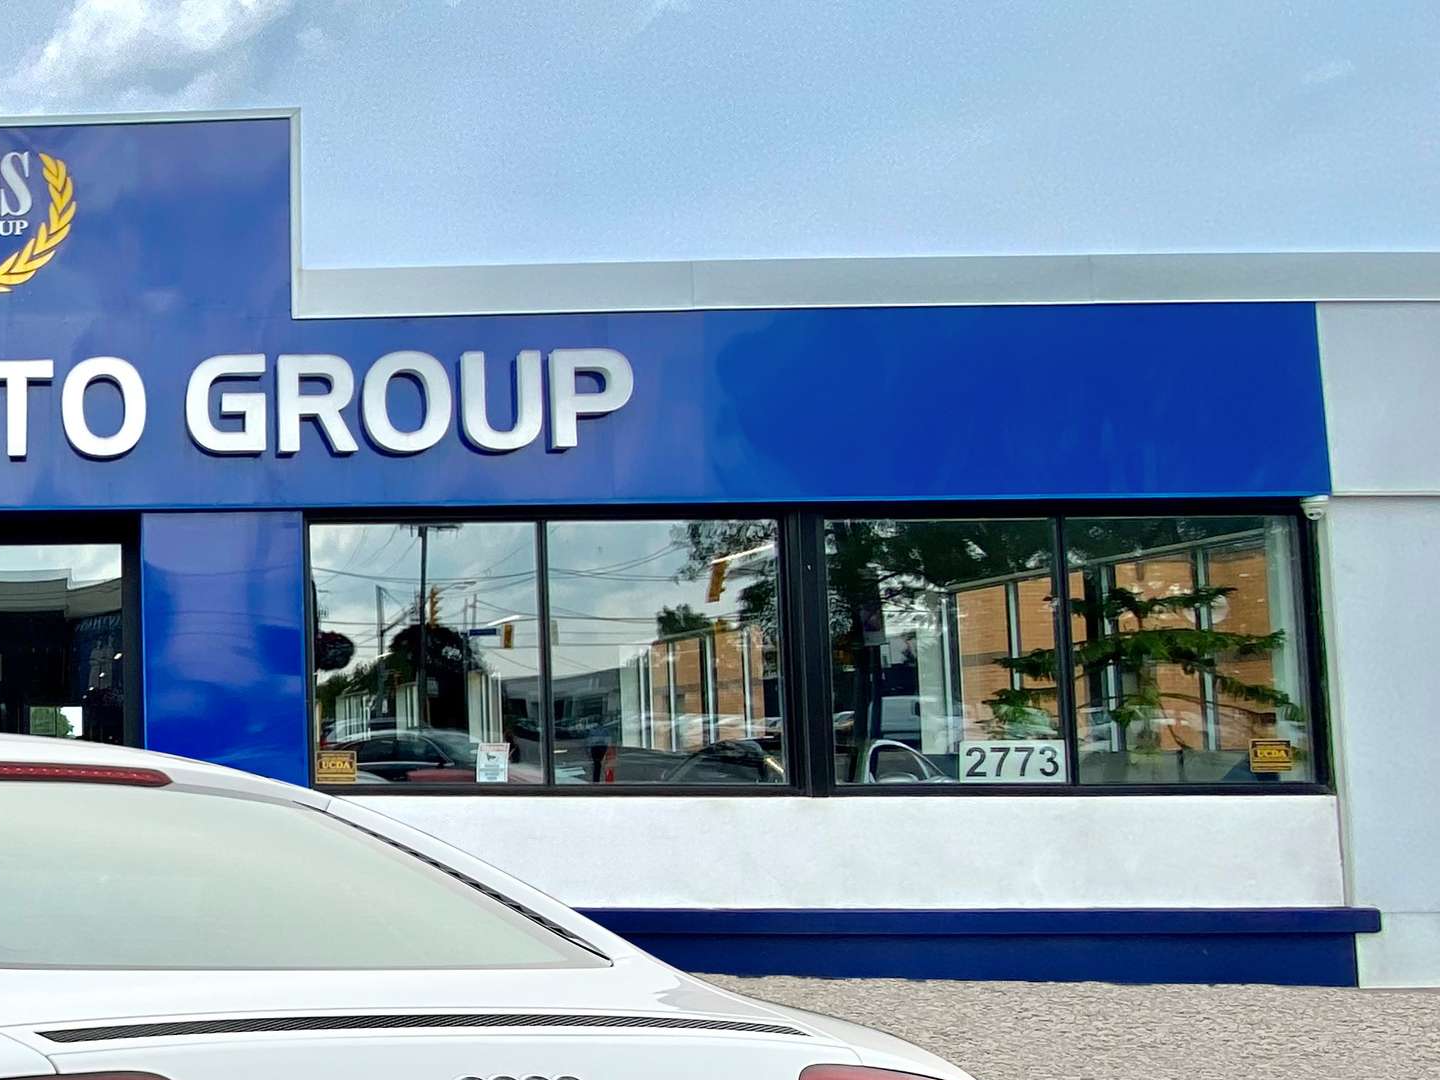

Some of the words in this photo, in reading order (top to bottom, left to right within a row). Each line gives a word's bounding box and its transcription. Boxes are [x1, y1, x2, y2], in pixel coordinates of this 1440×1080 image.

[185, 347, 635, 456] GROUP
[322, 761, 351, 769] UCDA
[964, 745, 1060, 777] 2773
